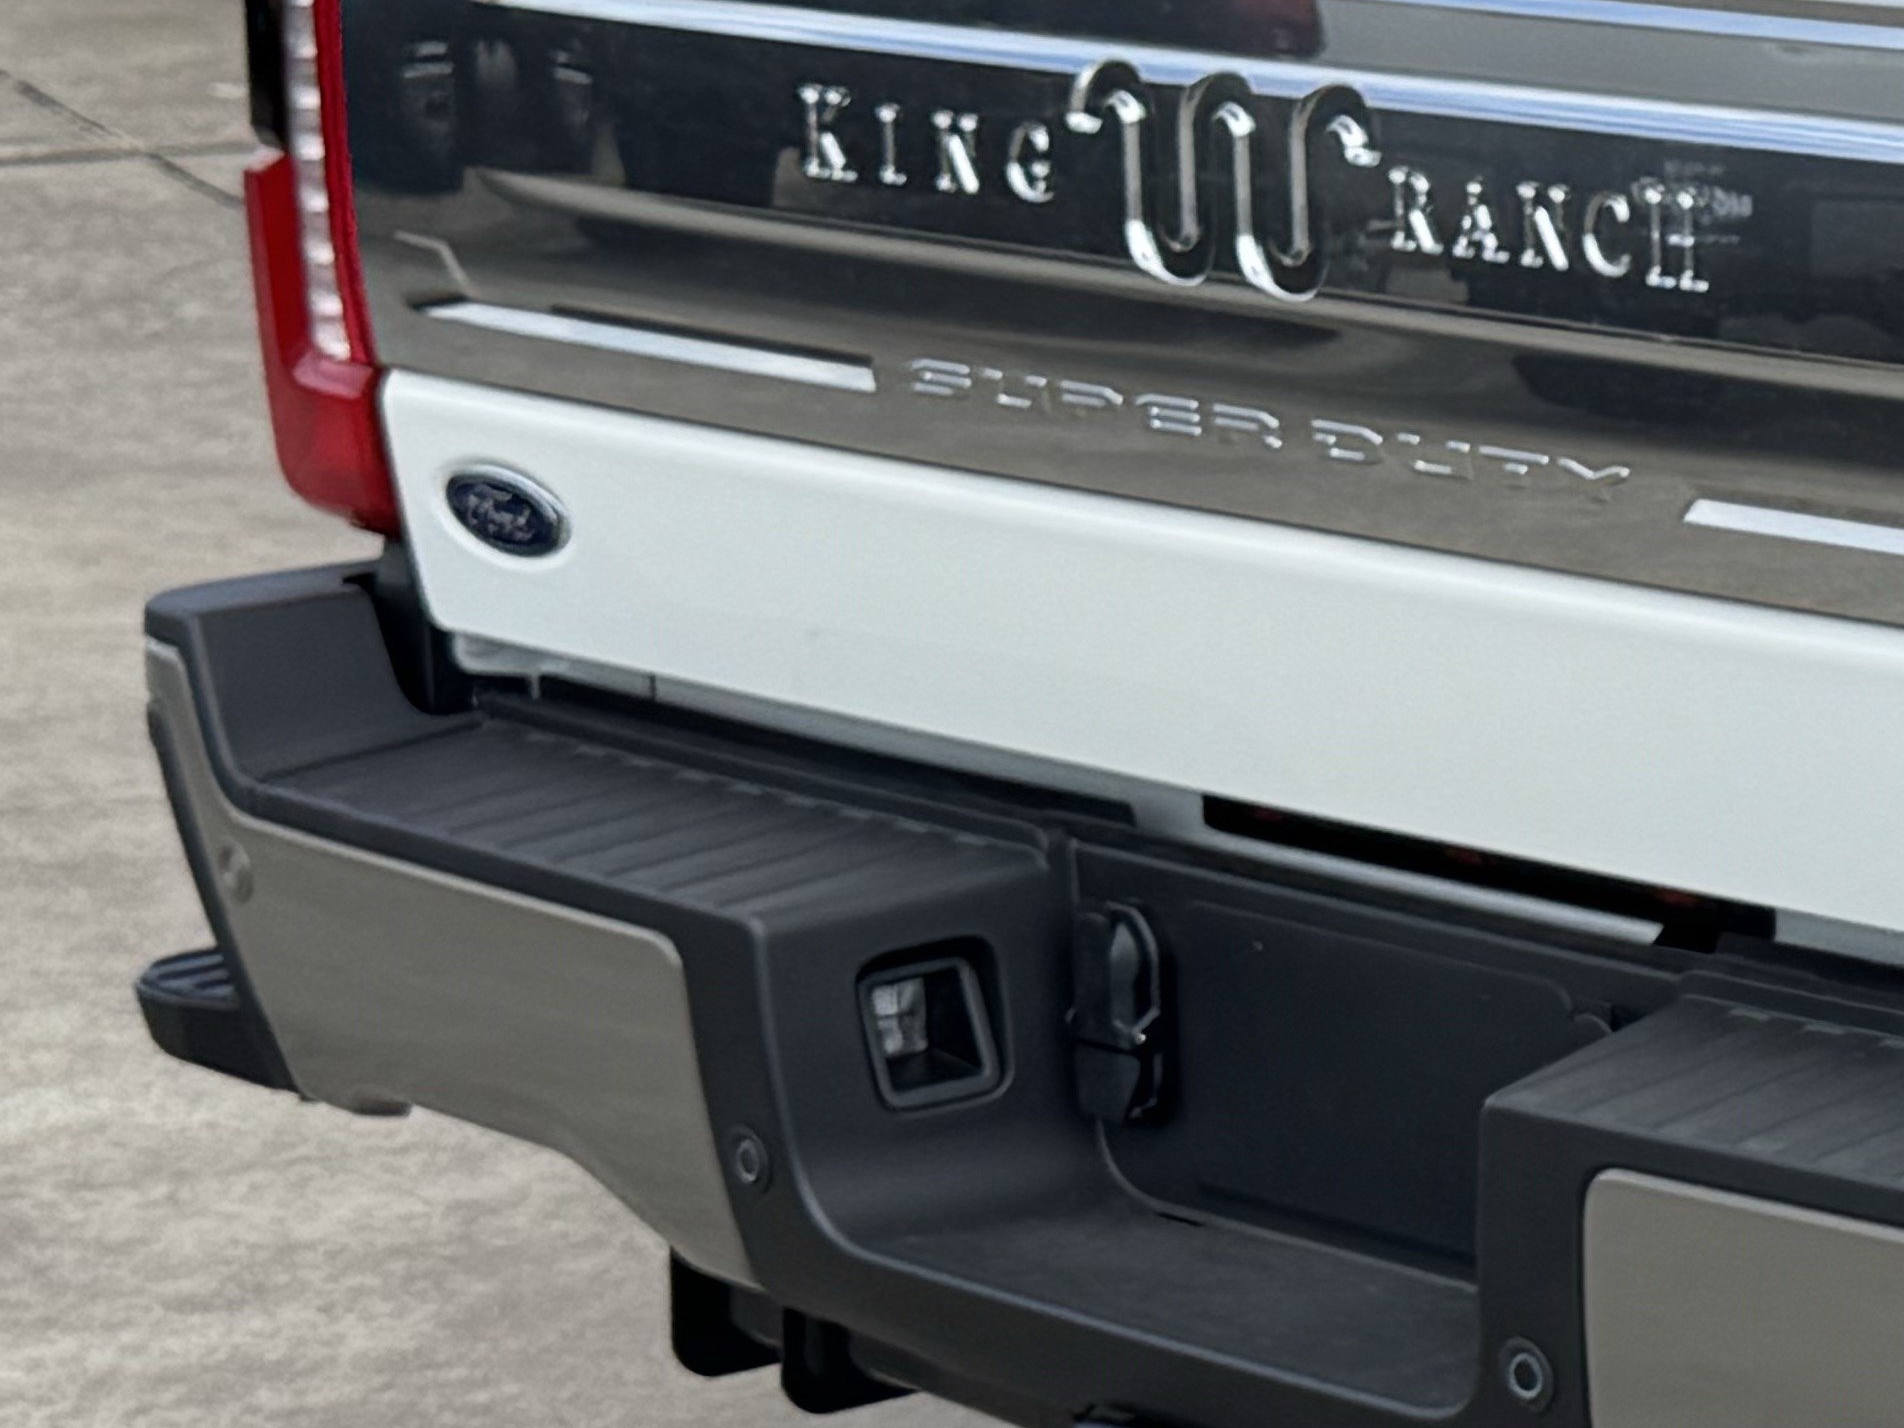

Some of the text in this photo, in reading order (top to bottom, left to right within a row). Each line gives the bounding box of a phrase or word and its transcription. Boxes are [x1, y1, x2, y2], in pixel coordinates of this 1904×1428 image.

[797, 83, 1056, 205] KING
[1387, 166, 1710, 294] RANCH
[906, 357, 1632, 500] SUPER DUTY
